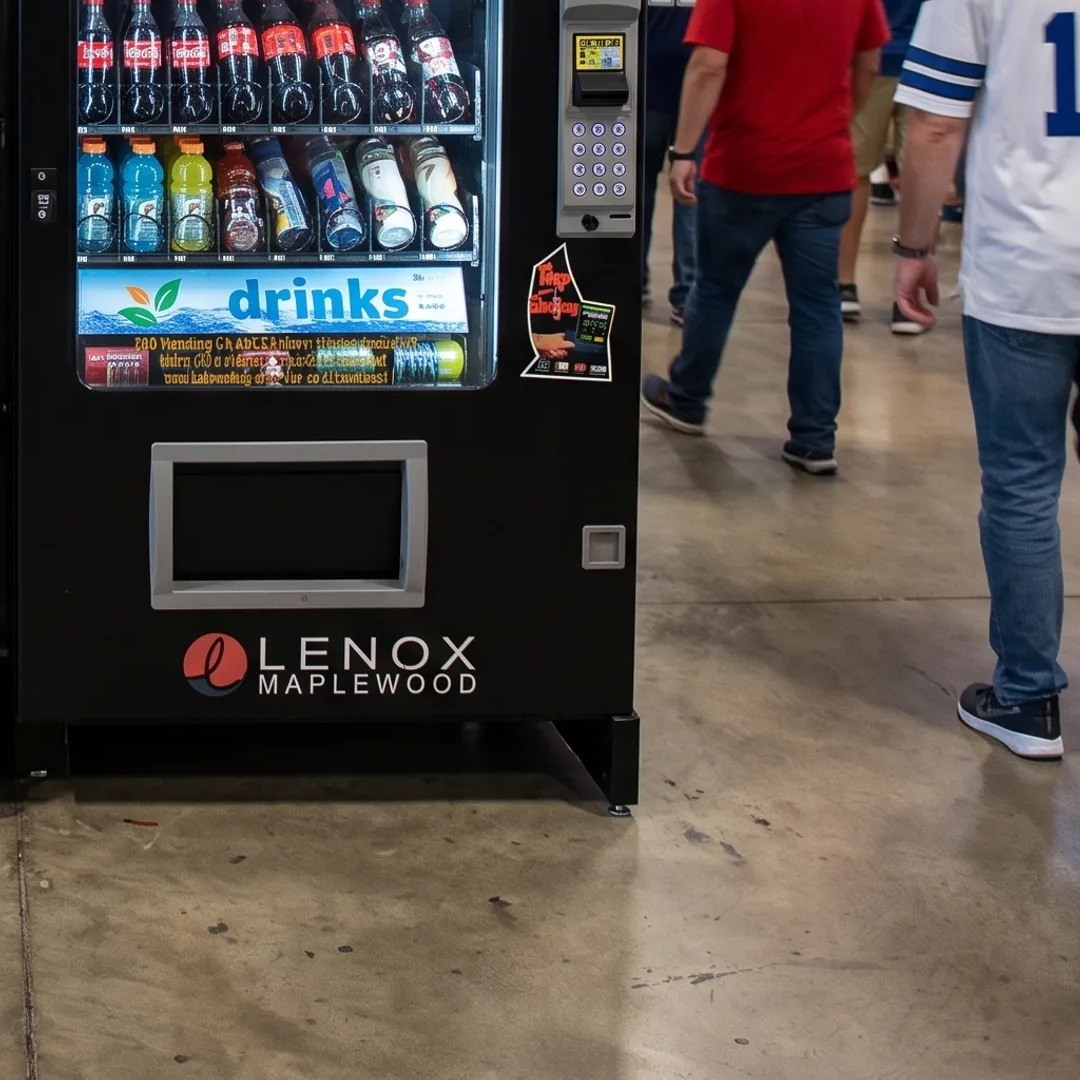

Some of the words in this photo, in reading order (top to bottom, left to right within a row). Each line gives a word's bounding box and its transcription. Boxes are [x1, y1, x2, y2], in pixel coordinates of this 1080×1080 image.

[228, 276, 410, 321] drinks
[260, 636, 476, 671] LENOX
[259, 673, 477, 695] MAPLEWOOD
